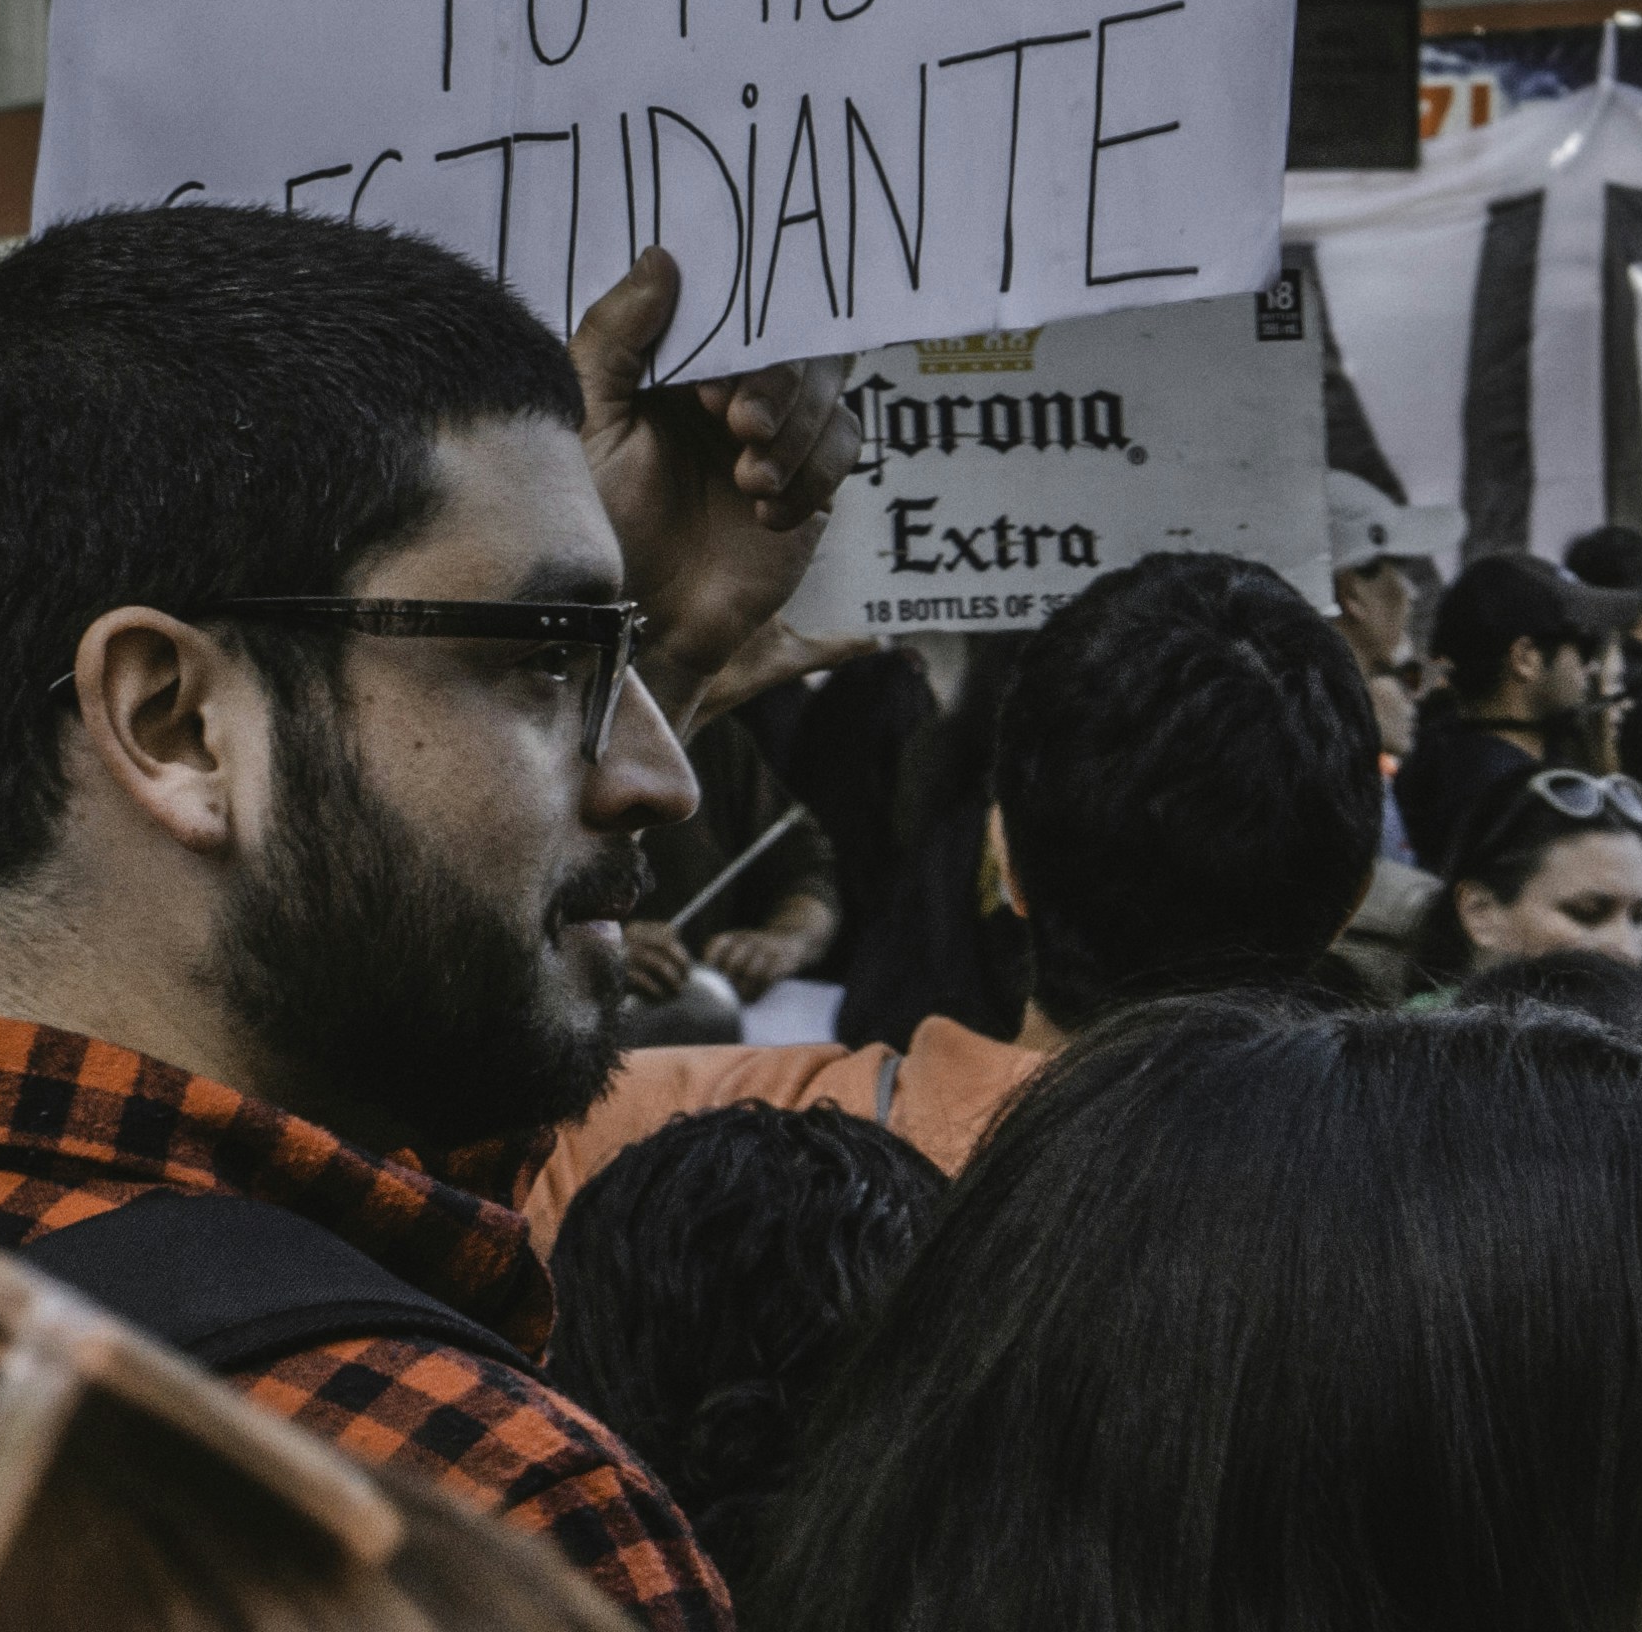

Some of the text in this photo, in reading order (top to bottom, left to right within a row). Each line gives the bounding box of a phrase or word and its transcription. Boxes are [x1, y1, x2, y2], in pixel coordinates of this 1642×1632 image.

[842, 372, 1132, 487] Corona
[886, 496, 1099, 575] Extra
[863, 599, 892, 623] 18
[897, 594, 1000, 622] BOTTLES
[1004, 593, 1035, 618] OF
